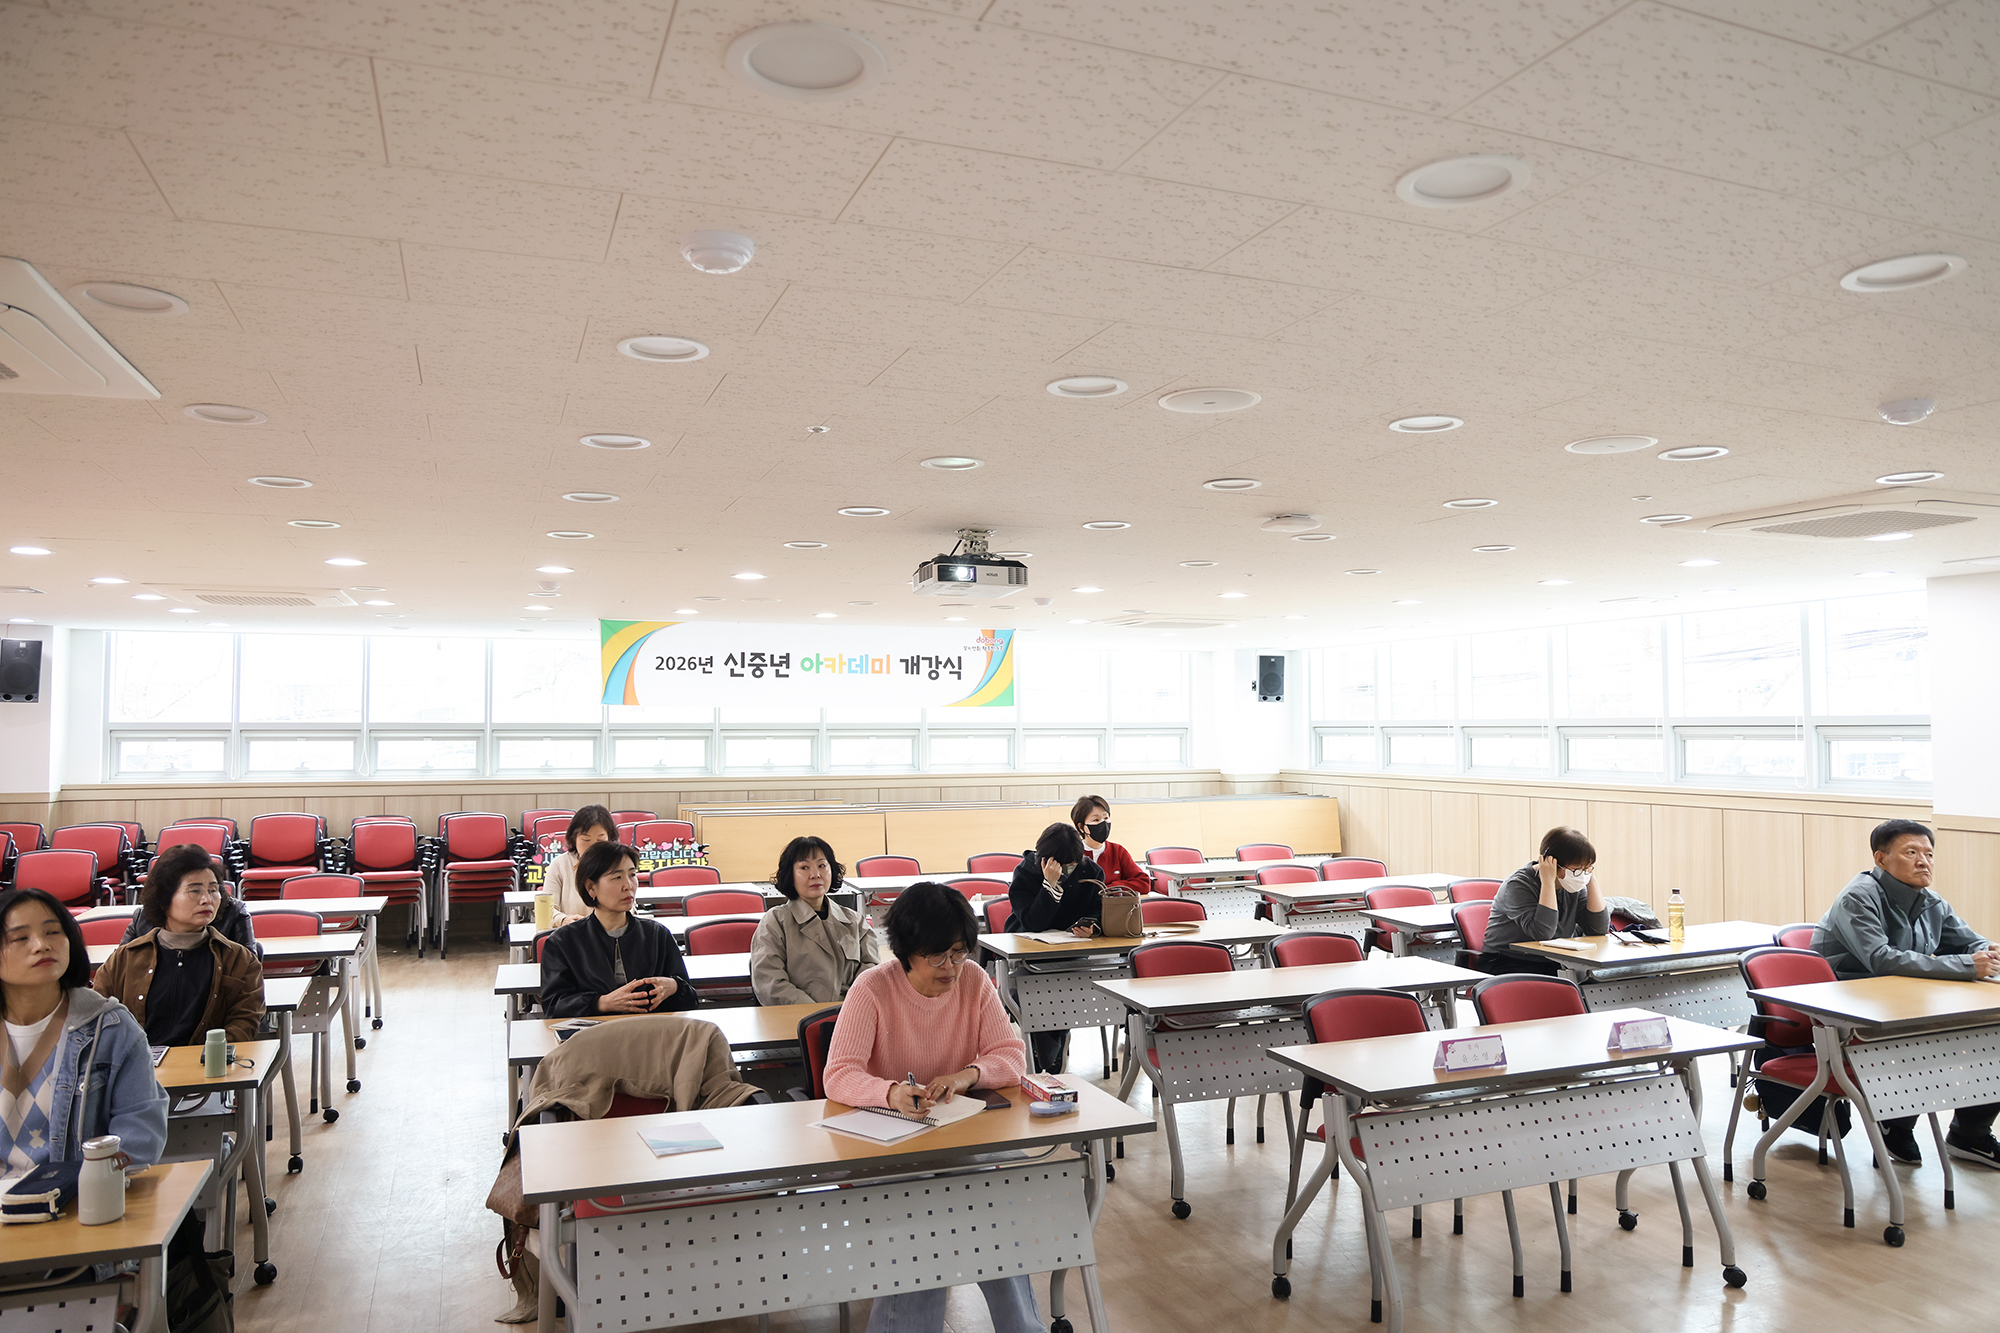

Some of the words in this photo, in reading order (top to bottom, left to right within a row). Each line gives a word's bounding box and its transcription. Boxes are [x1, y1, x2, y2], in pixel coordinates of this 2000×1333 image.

[975, 636, 1004, 645] dobong
[655, 656, 714, 675] 2026년
[724, 652, 791, 679] 신중년
[800, 653, 891, 675] 아카데미
[900, 655, 963, 681] 개강식
[639, 849, 696, 860] 고맙습니다
